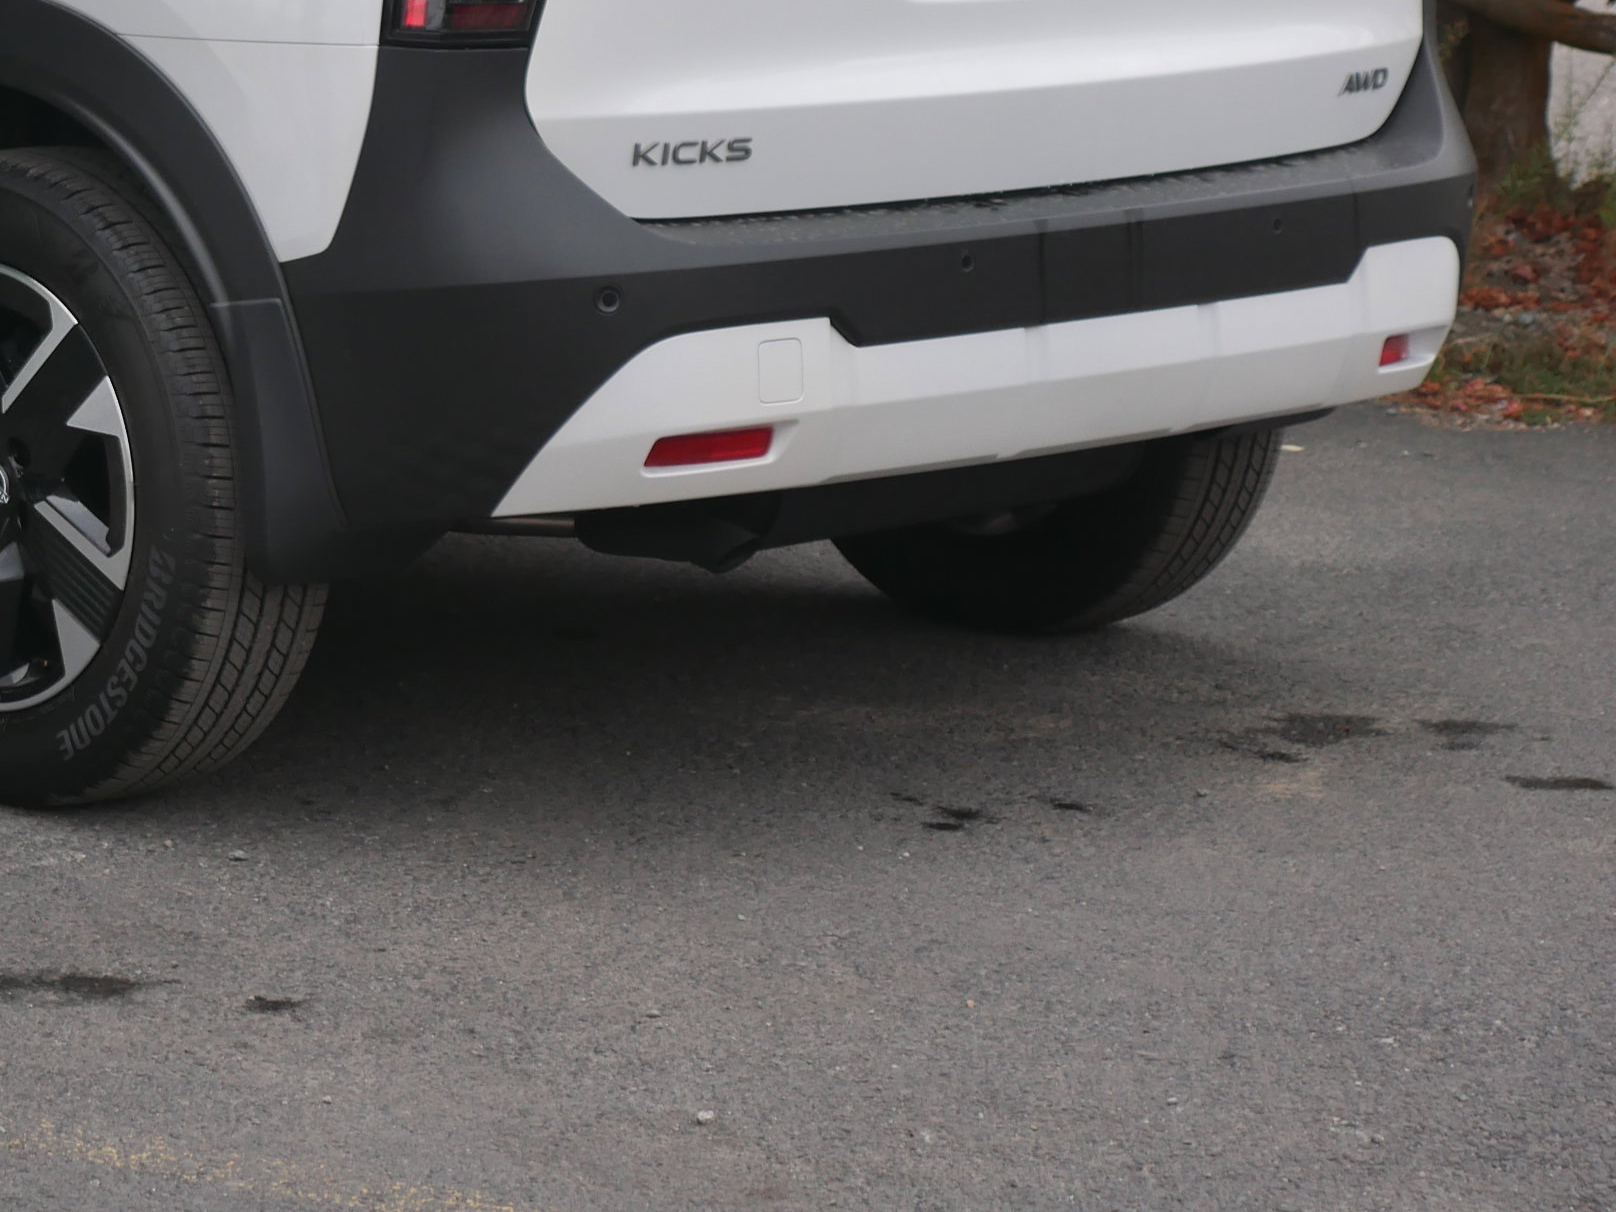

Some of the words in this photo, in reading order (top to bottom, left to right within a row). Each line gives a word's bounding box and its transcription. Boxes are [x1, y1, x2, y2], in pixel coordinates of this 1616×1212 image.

[1337, 67, 1389, 96] AWD
[632, 137, 753, 167] KICKS
[55, 544, 177, 762] BRIDGESTONE
